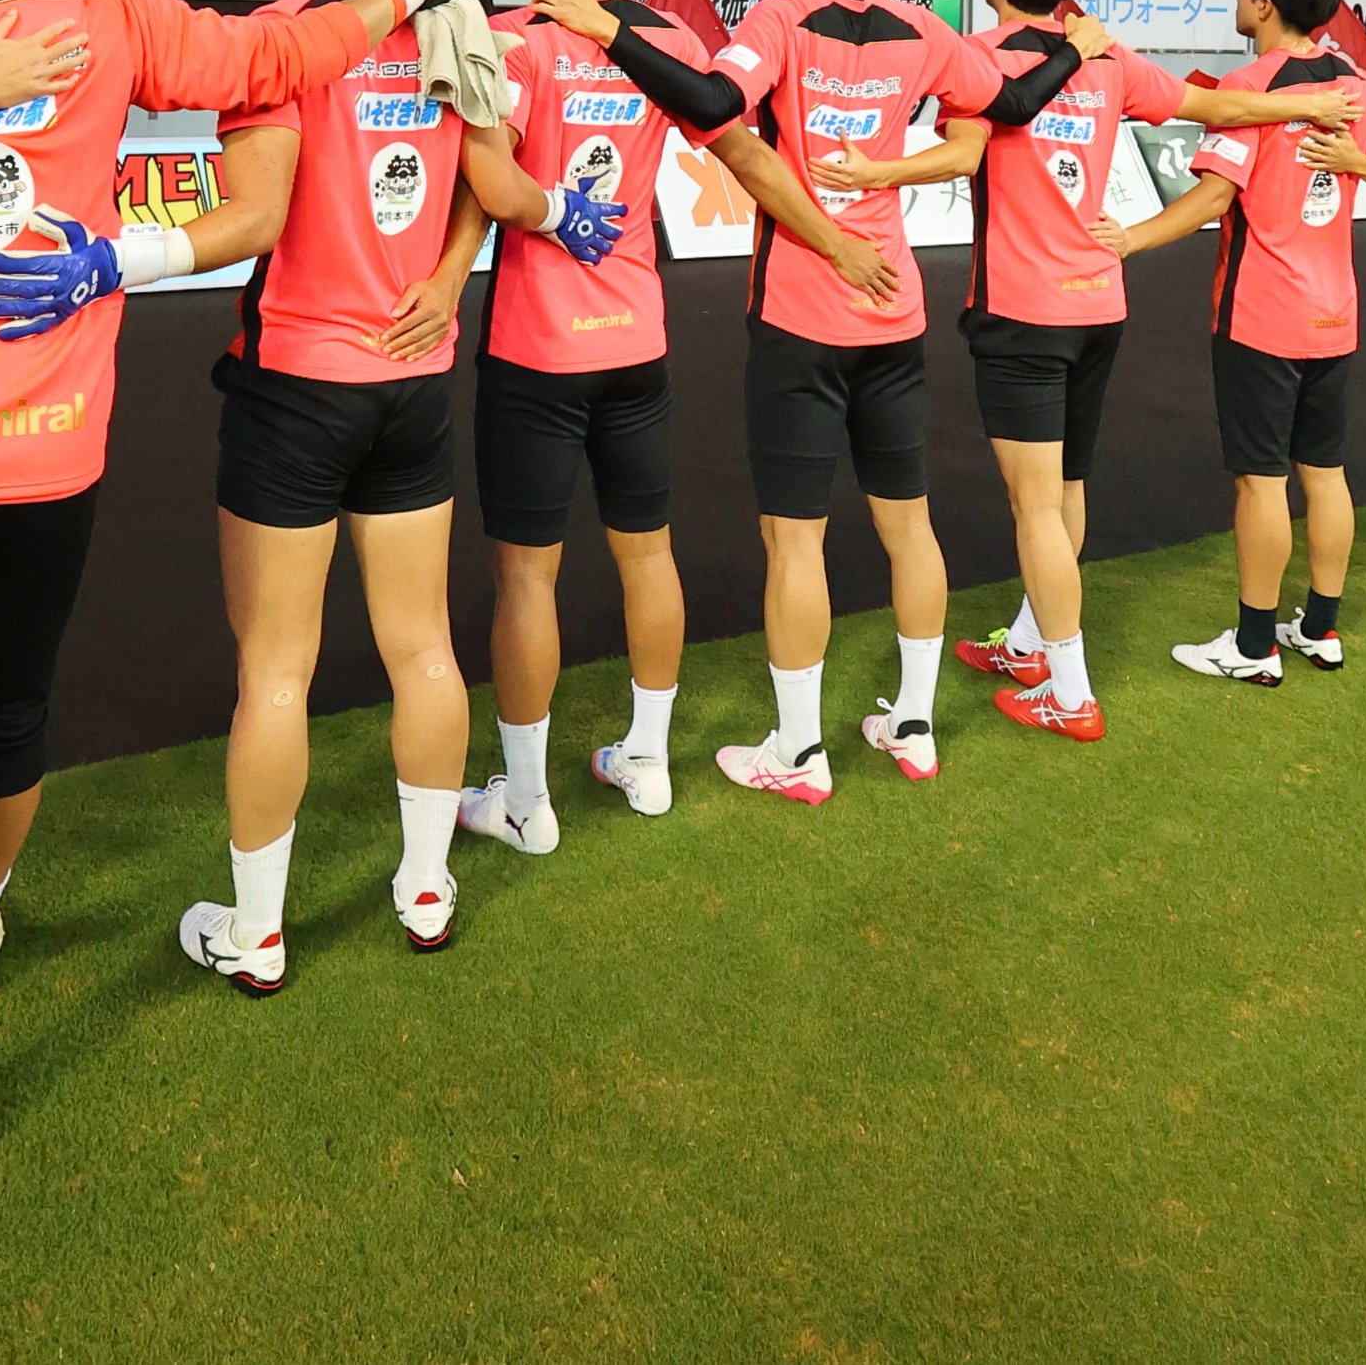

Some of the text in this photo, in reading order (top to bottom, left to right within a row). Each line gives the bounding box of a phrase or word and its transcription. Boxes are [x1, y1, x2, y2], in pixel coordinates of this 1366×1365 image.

[358, 97, 438, 127] いそざきの家
[565, 96, 642, 122] いそざきの家
[809, 109, 877, 137] いそざきの家
[384, 210, 415, 223] 熊本市
